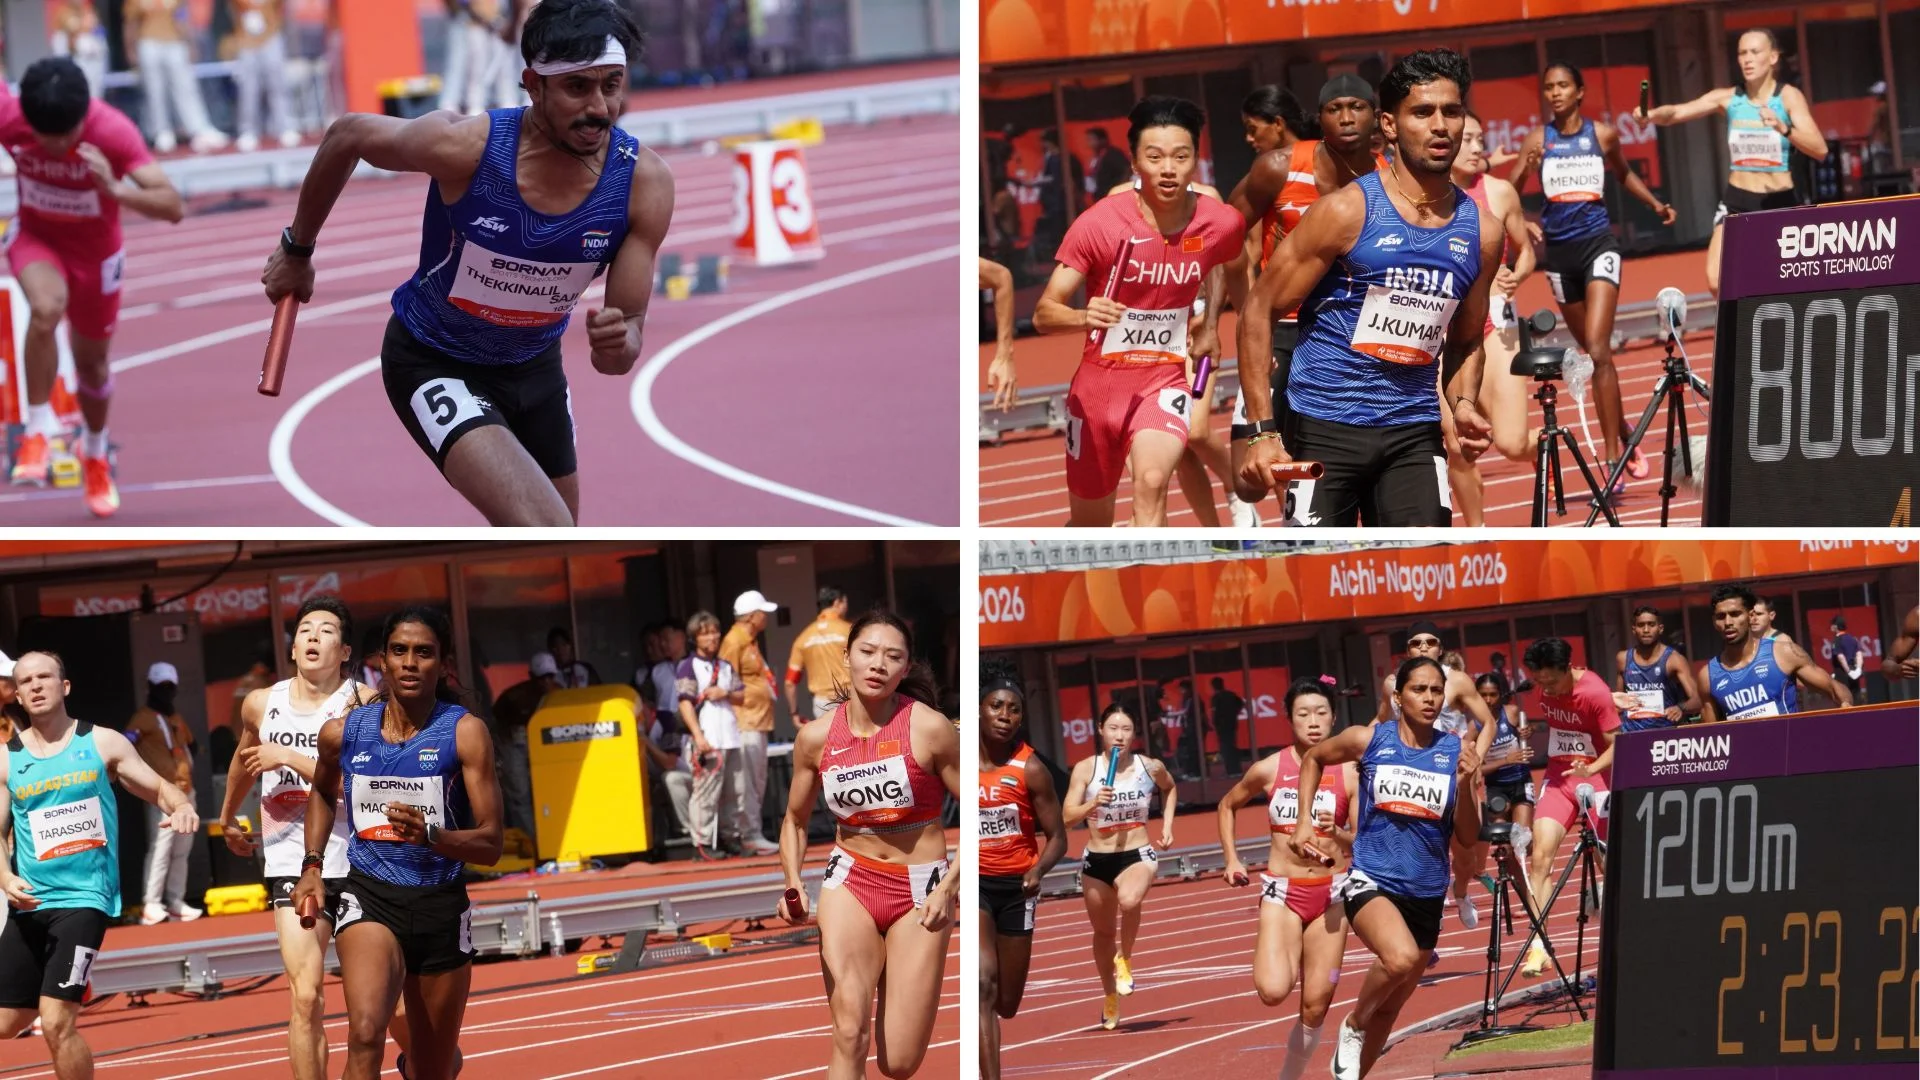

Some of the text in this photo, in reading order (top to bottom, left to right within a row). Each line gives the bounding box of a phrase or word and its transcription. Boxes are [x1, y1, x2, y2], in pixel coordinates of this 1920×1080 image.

[1556, 160, 1593, 169] BORNAN
[1550, 174, 1600, 187] MENDIS
[773, 157, 812, 233] 3
[470, 217, 510, 233] JSW
[582, 238, 609, 248] INDIA
[1777, 217, 1897, 259] BORNAN
[1450, 243, 1469, 255] INDIA
[490, 258, 572, 276] BORNAN
[1123, 259, 1201, 285] CHINA
[1604, 255, 1614, 274] 3
[1780, 254, 1895, 278] SPORTS TECHNOLOGY
[466, 265, 561, 297] THEKKINALIL
[1385, 267, 1454, 298] INDIA
[1389, 294, 1445, 312] BORNAN
[1128, 312, 1177, 321] BORNAN
[1122, 327, 1172, 345] XIAO
[1368, 313, 1441, 341] J.KUMAR
[1749, 294, 1918, 462] 800
[422, 384, 458, 426] 5
[1171, 394, 1186, 415] 4
[1329, 552, 1507, 602] Aichi-Nagoya 2026
[1640, 682, 1665, 690] LANKA
[1724, 683, 1769, 712] INDIA
[549, 721, 614, 738] BORNAN
[269, 732, 318, 748] KORE
[1557, 741, 1585, 752] XIAO
[1650, 735, 1730, 762] BORNAN
[836, 764, 887, 783] BORNAN
[1392, 768, 1435, 781] BORNAN
[1652, 760, 1729, 776] SPORTS TECHNOLOGY
[15, 769, 99, 801] QAZAQSTAN
[369, 780, 424, 791] BORNAN
[979, 785, 1001, 802] AE
[1379, 780, 1443, 804] KIRAN
[833, 780, 903, 809] KONG
[893, 796, 910, 807] 260
[1111, 790, 1145, 802] OREA
[44, 803, 87, 819] BORNAN
[1104, 809, 1140, 822] A.LEE
[38, 818, 98, 841] TARASSOV
[1636, 783, 1797, 899] 1200m
[1265, 881, 1277, 898] 4
[83, 952, 93, 980] 7
